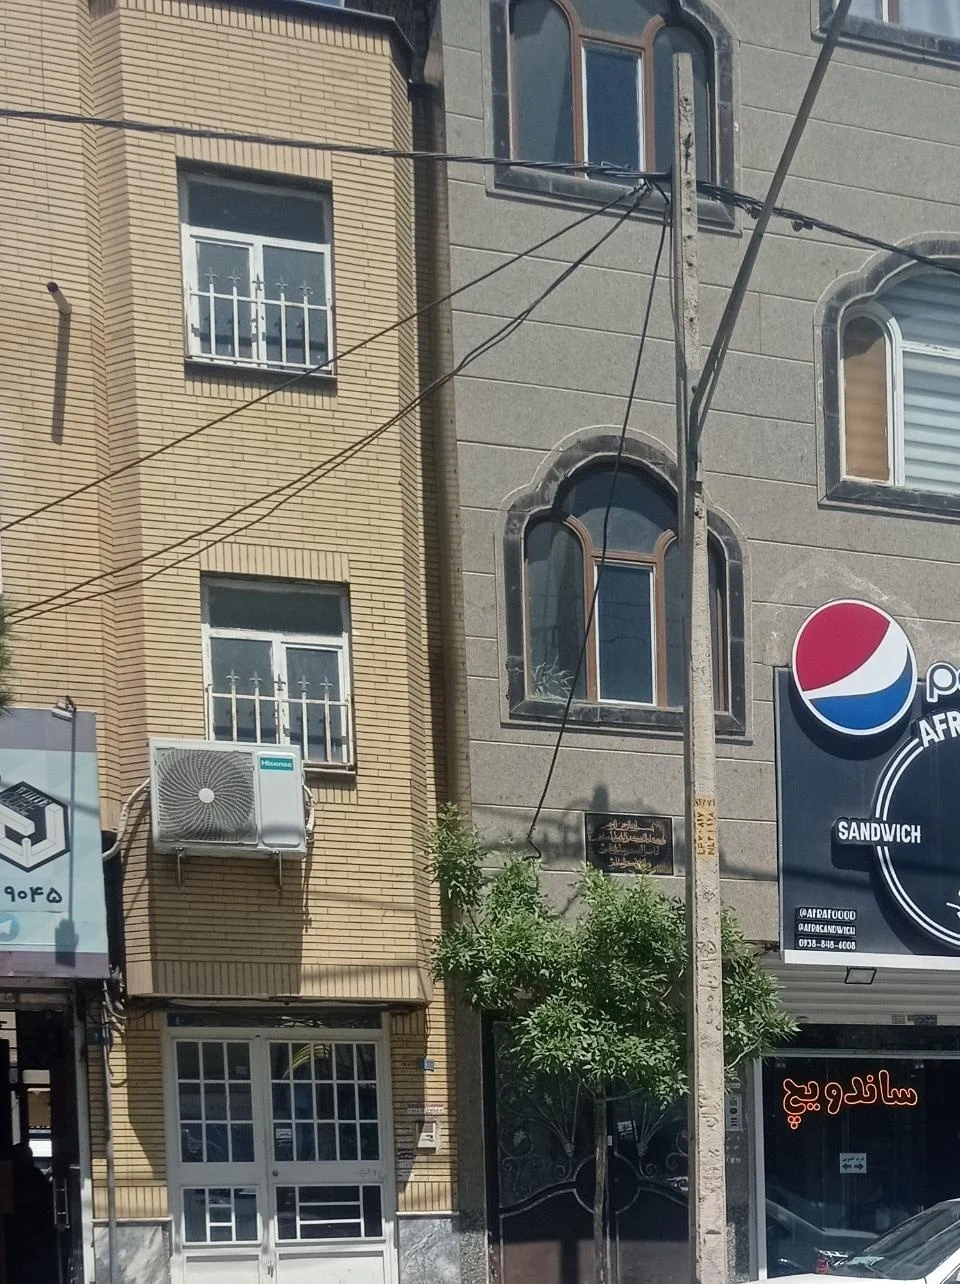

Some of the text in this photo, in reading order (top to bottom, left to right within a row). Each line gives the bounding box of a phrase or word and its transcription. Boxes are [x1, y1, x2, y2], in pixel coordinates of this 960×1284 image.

[261, 759, 293, 768] Hisense
[837, 820, 922, 844] SANDWICH
[783, 1069, 918, 1129] ساندویچ
